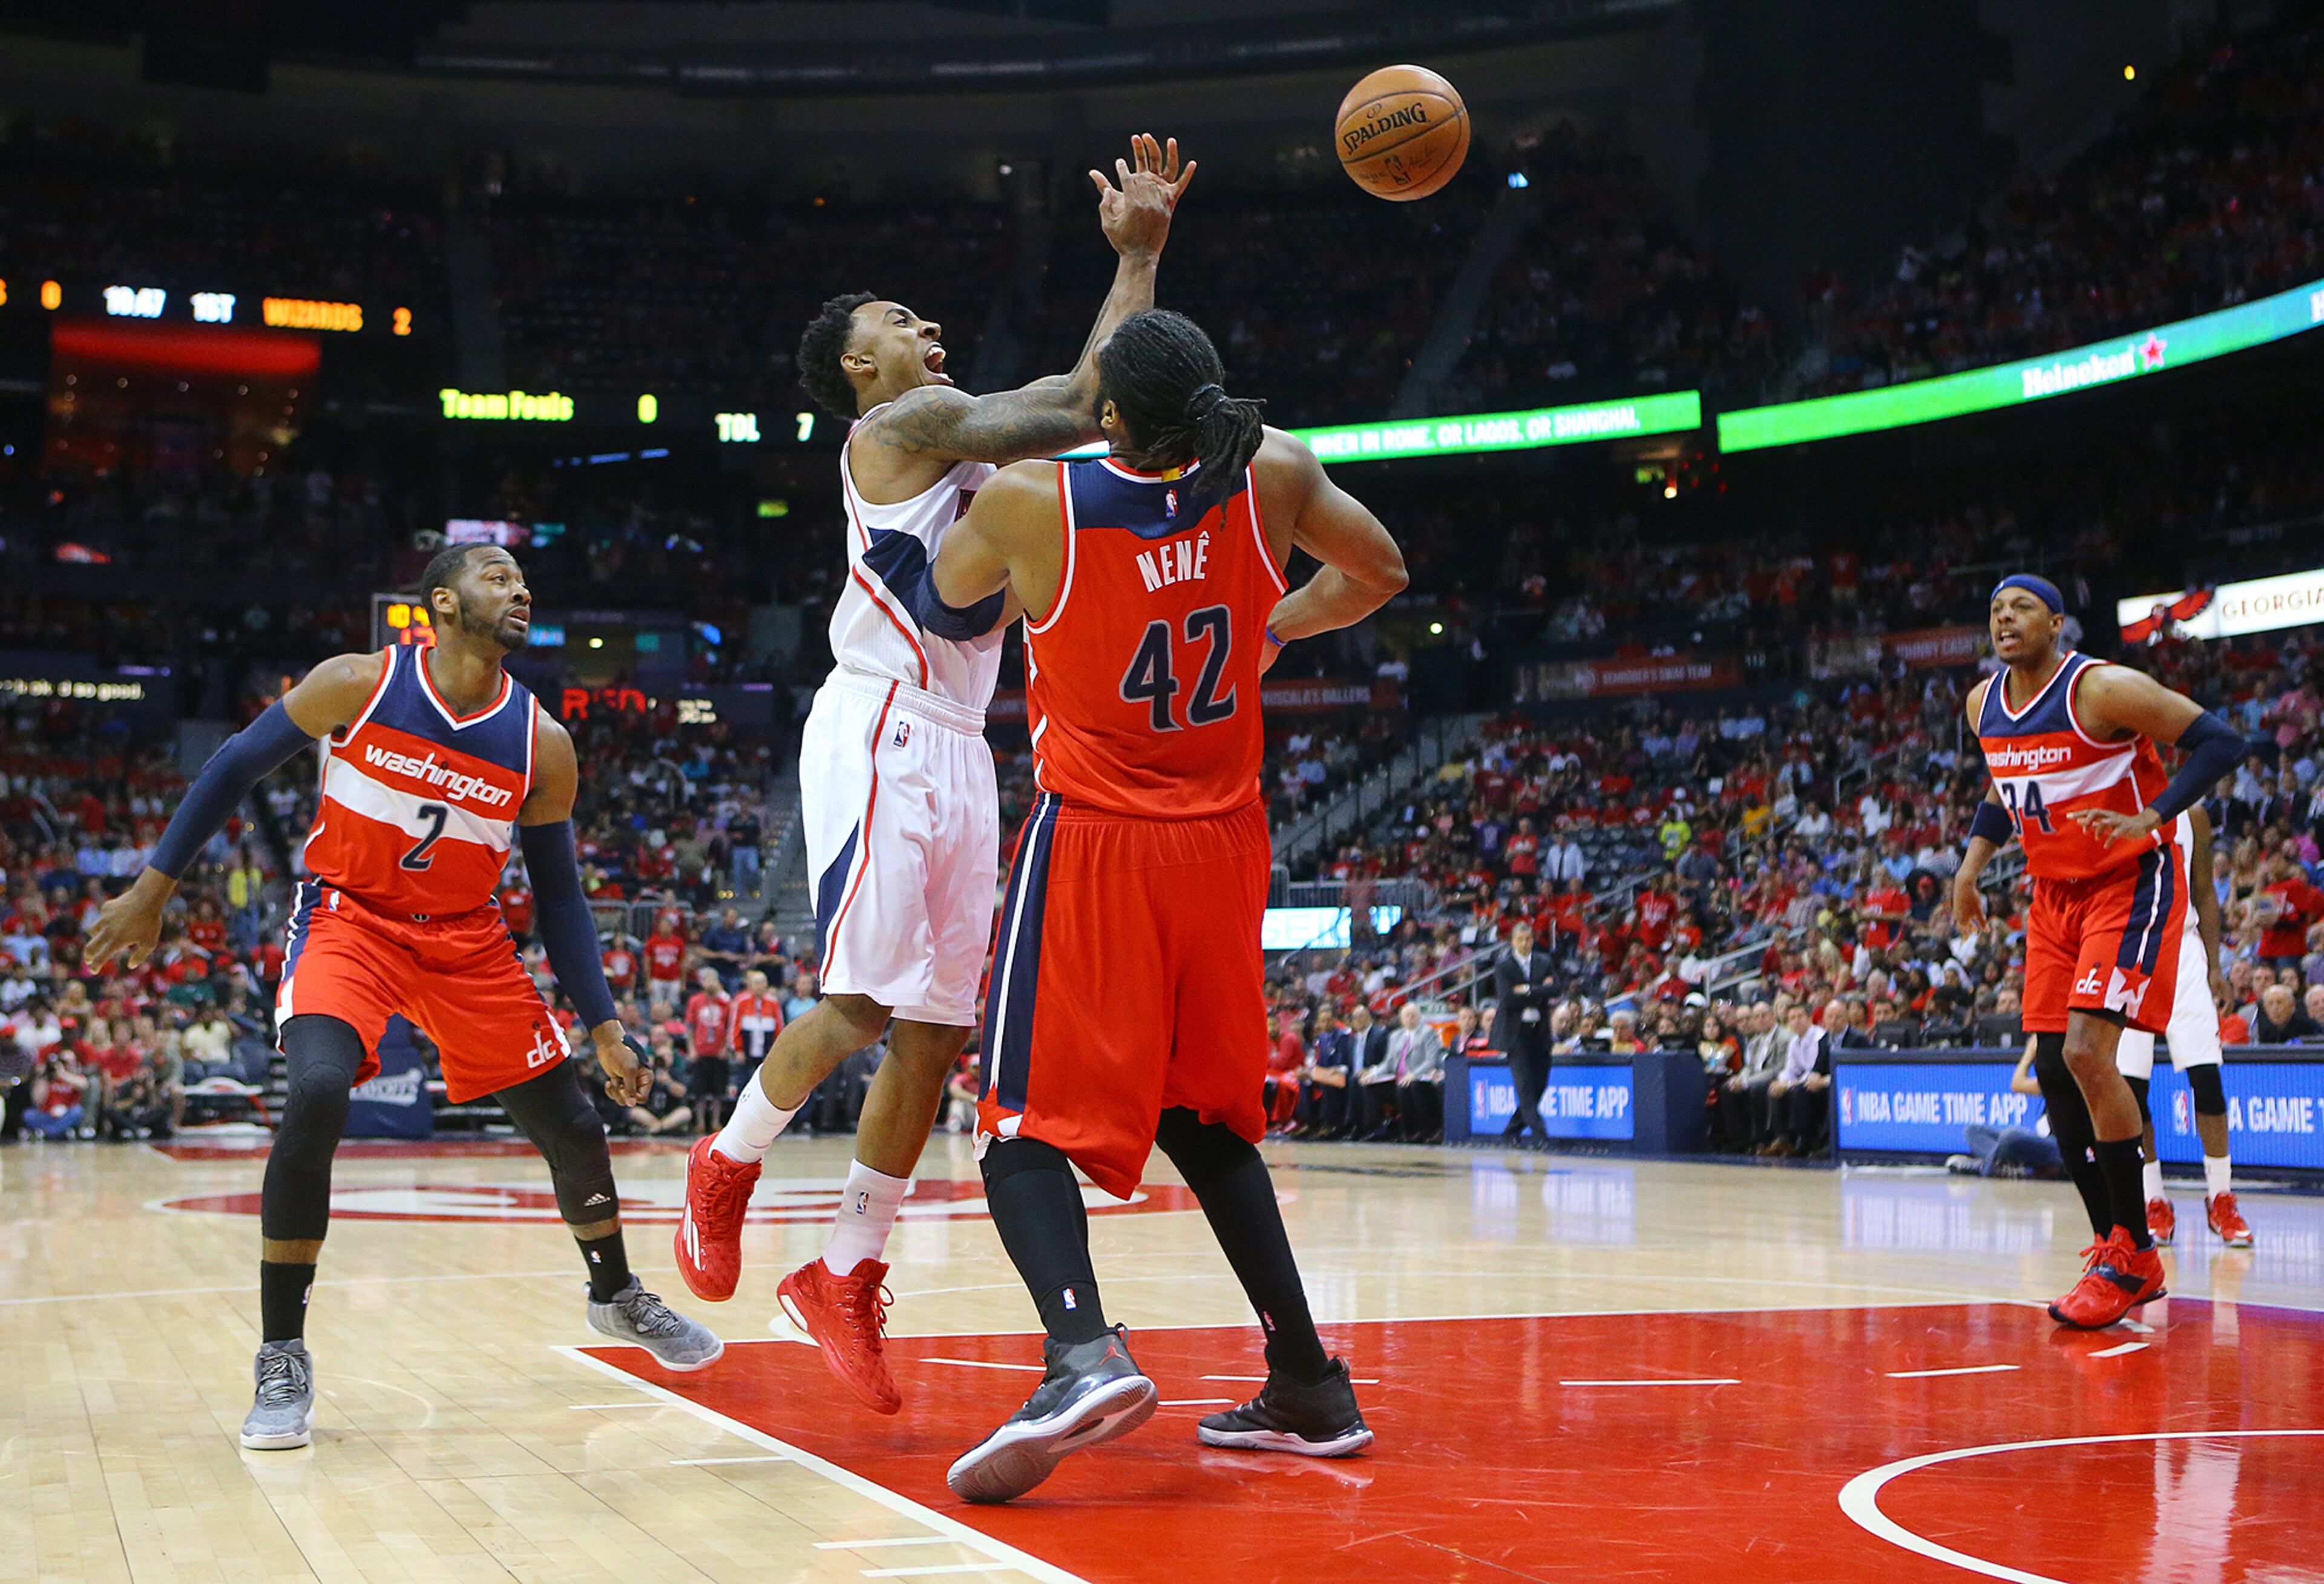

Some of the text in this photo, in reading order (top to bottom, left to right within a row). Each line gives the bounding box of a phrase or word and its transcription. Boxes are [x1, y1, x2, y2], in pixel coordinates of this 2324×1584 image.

[1343, 102, 1427, 156] SPALDING
[41, 280, 62, 310] 0
[263, 297, 363, 332] WIZARDS
[393, 307, 412, 335] 2
[2022, 351, 2136, 398] Heineken
[439, 388, 814, 442] Team Fouls 0 TOL 7
[1310, 406, 1641, 456] WHEN IN ROME. OR LAGOS. OR SHANGHAI.
[1135, 530, 1210, 593] NENÊ
[1119, 604, 1236, 733] 42
[365, 744, 513, 807] washington
[399, 804, 448, 872] 2
[526, 1030, 557, 1068] dc
[1558, 1086, 1594, 1117] TIME
[1595, 1086, 1629, 1119] APP
[1859, 1091, 2028, 1126] NBA GAME TIME APP
[2247, 1096, 2315, 1134] GAME
